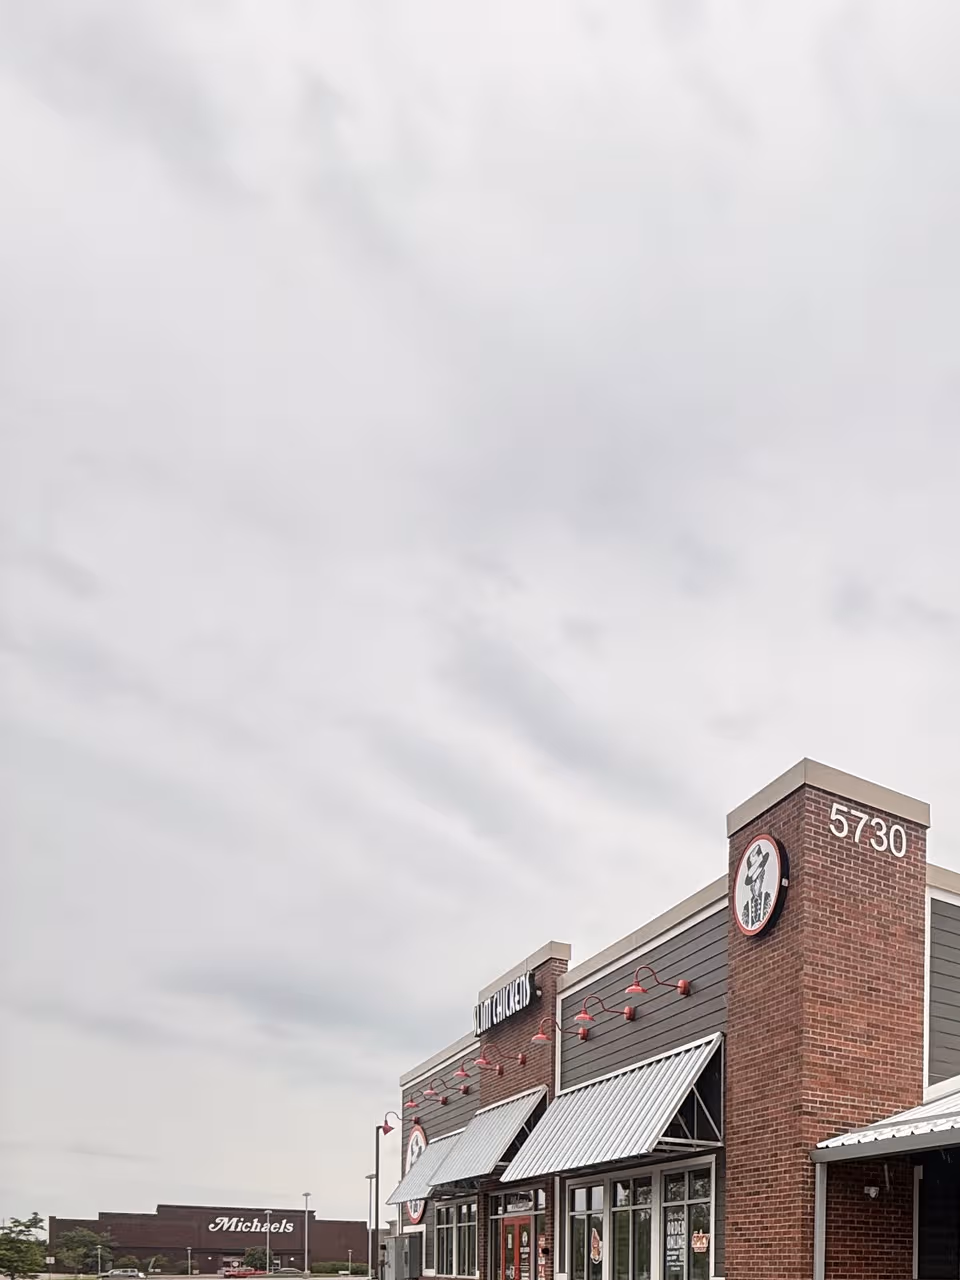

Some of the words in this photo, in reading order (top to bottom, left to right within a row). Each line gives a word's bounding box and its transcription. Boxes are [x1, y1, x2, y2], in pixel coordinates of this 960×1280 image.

[829, 802, 907, 858] 5730
[492, 970, 531, 1025] CHICKENS
[208, 1216, 294, 1233] Michaels
